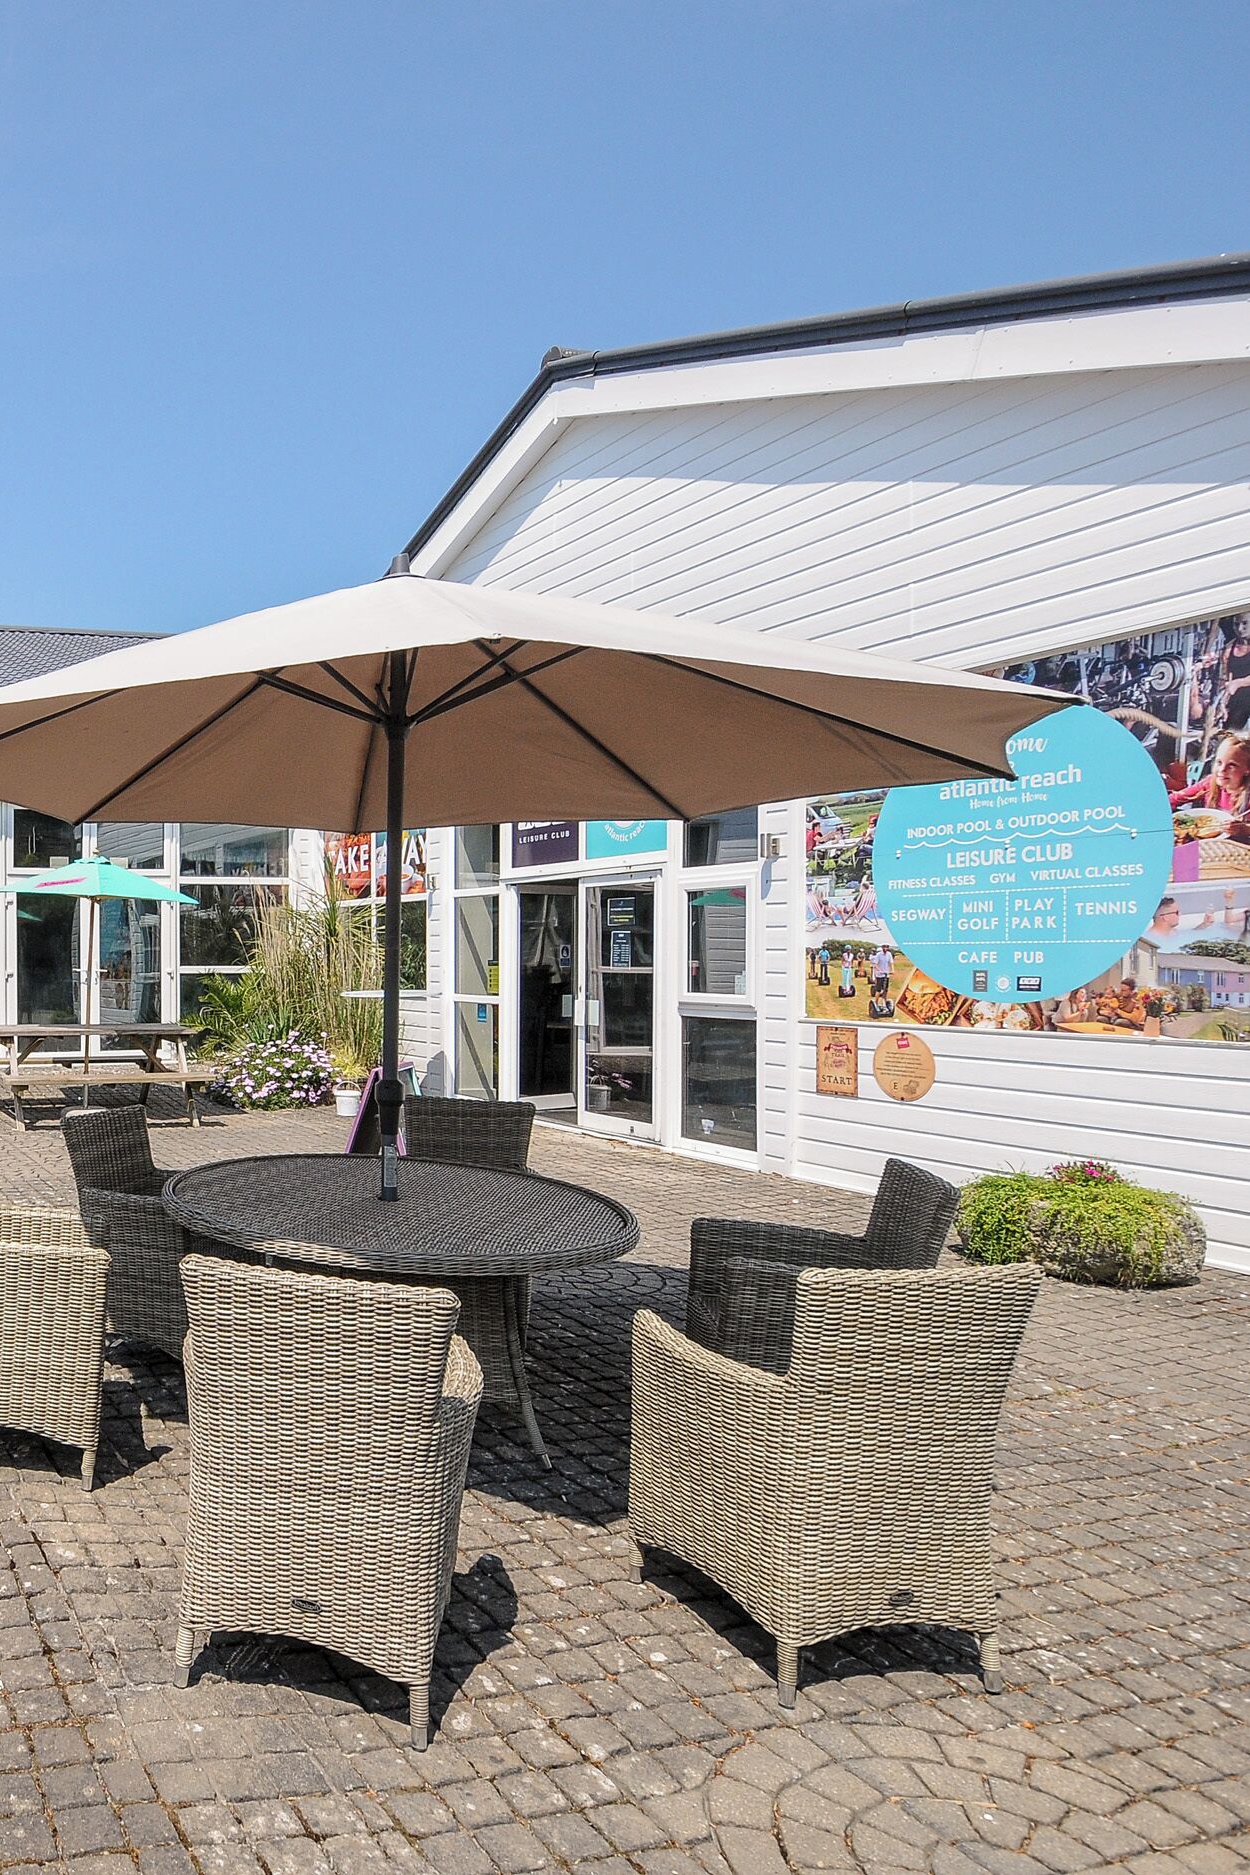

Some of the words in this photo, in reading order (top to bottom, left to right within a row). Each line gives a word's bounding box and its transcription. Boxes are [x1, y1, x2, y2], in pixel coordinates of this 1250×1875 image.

[939, 778, 1016, 800] atlantic
[1021, 763, 1082, 789] reach
[969, 798, 994, 809] Home
[996, 795, 1018, 808] from
[1021, 791, 1047, 804] Home
[907, 825, 954, 839] INDOOR
[957, 820, 992, 834] POOL
[995, 819, 1004, 830] &
[1008, 810, 1079, 829] OUTDOOR
[1083, 806, 1126, 821] POOL
[518, 833, 548, 844] LEISURE
[551, 830, 570, 840] CLUB
[604, 823, 629, 842] atlantic
[629, 820, 647, 840] reac
[946, 847, 1016, 869] LEISURE
[1021, 842, 1074, 862] CLUB
[989, 873, 1016, 884] GYM
[1031, 867, 1082, 882] VIRTUAL
[1085, 863, 1144, 879] CLASSES
[888, 878, 927, 890] FITNESS
[930, 875, 976, 887] CLASSES
[962, 900, 994, 914] MINI
[1014, 898, 1055, 912] PLAY
[1074, 900, 1138, 916] TENNIS
[891, 907, 946, 922] SEGWAY
[957, 918, 999, 931] GOLF
[1012, 916, 1057, 930] PARK
[958, 951, 998, 964] CAFE
[1013, 951, 1045, 964] PUB
[821, 1075, 852, 1085] START
[893, 1082, 898, 1090] E
